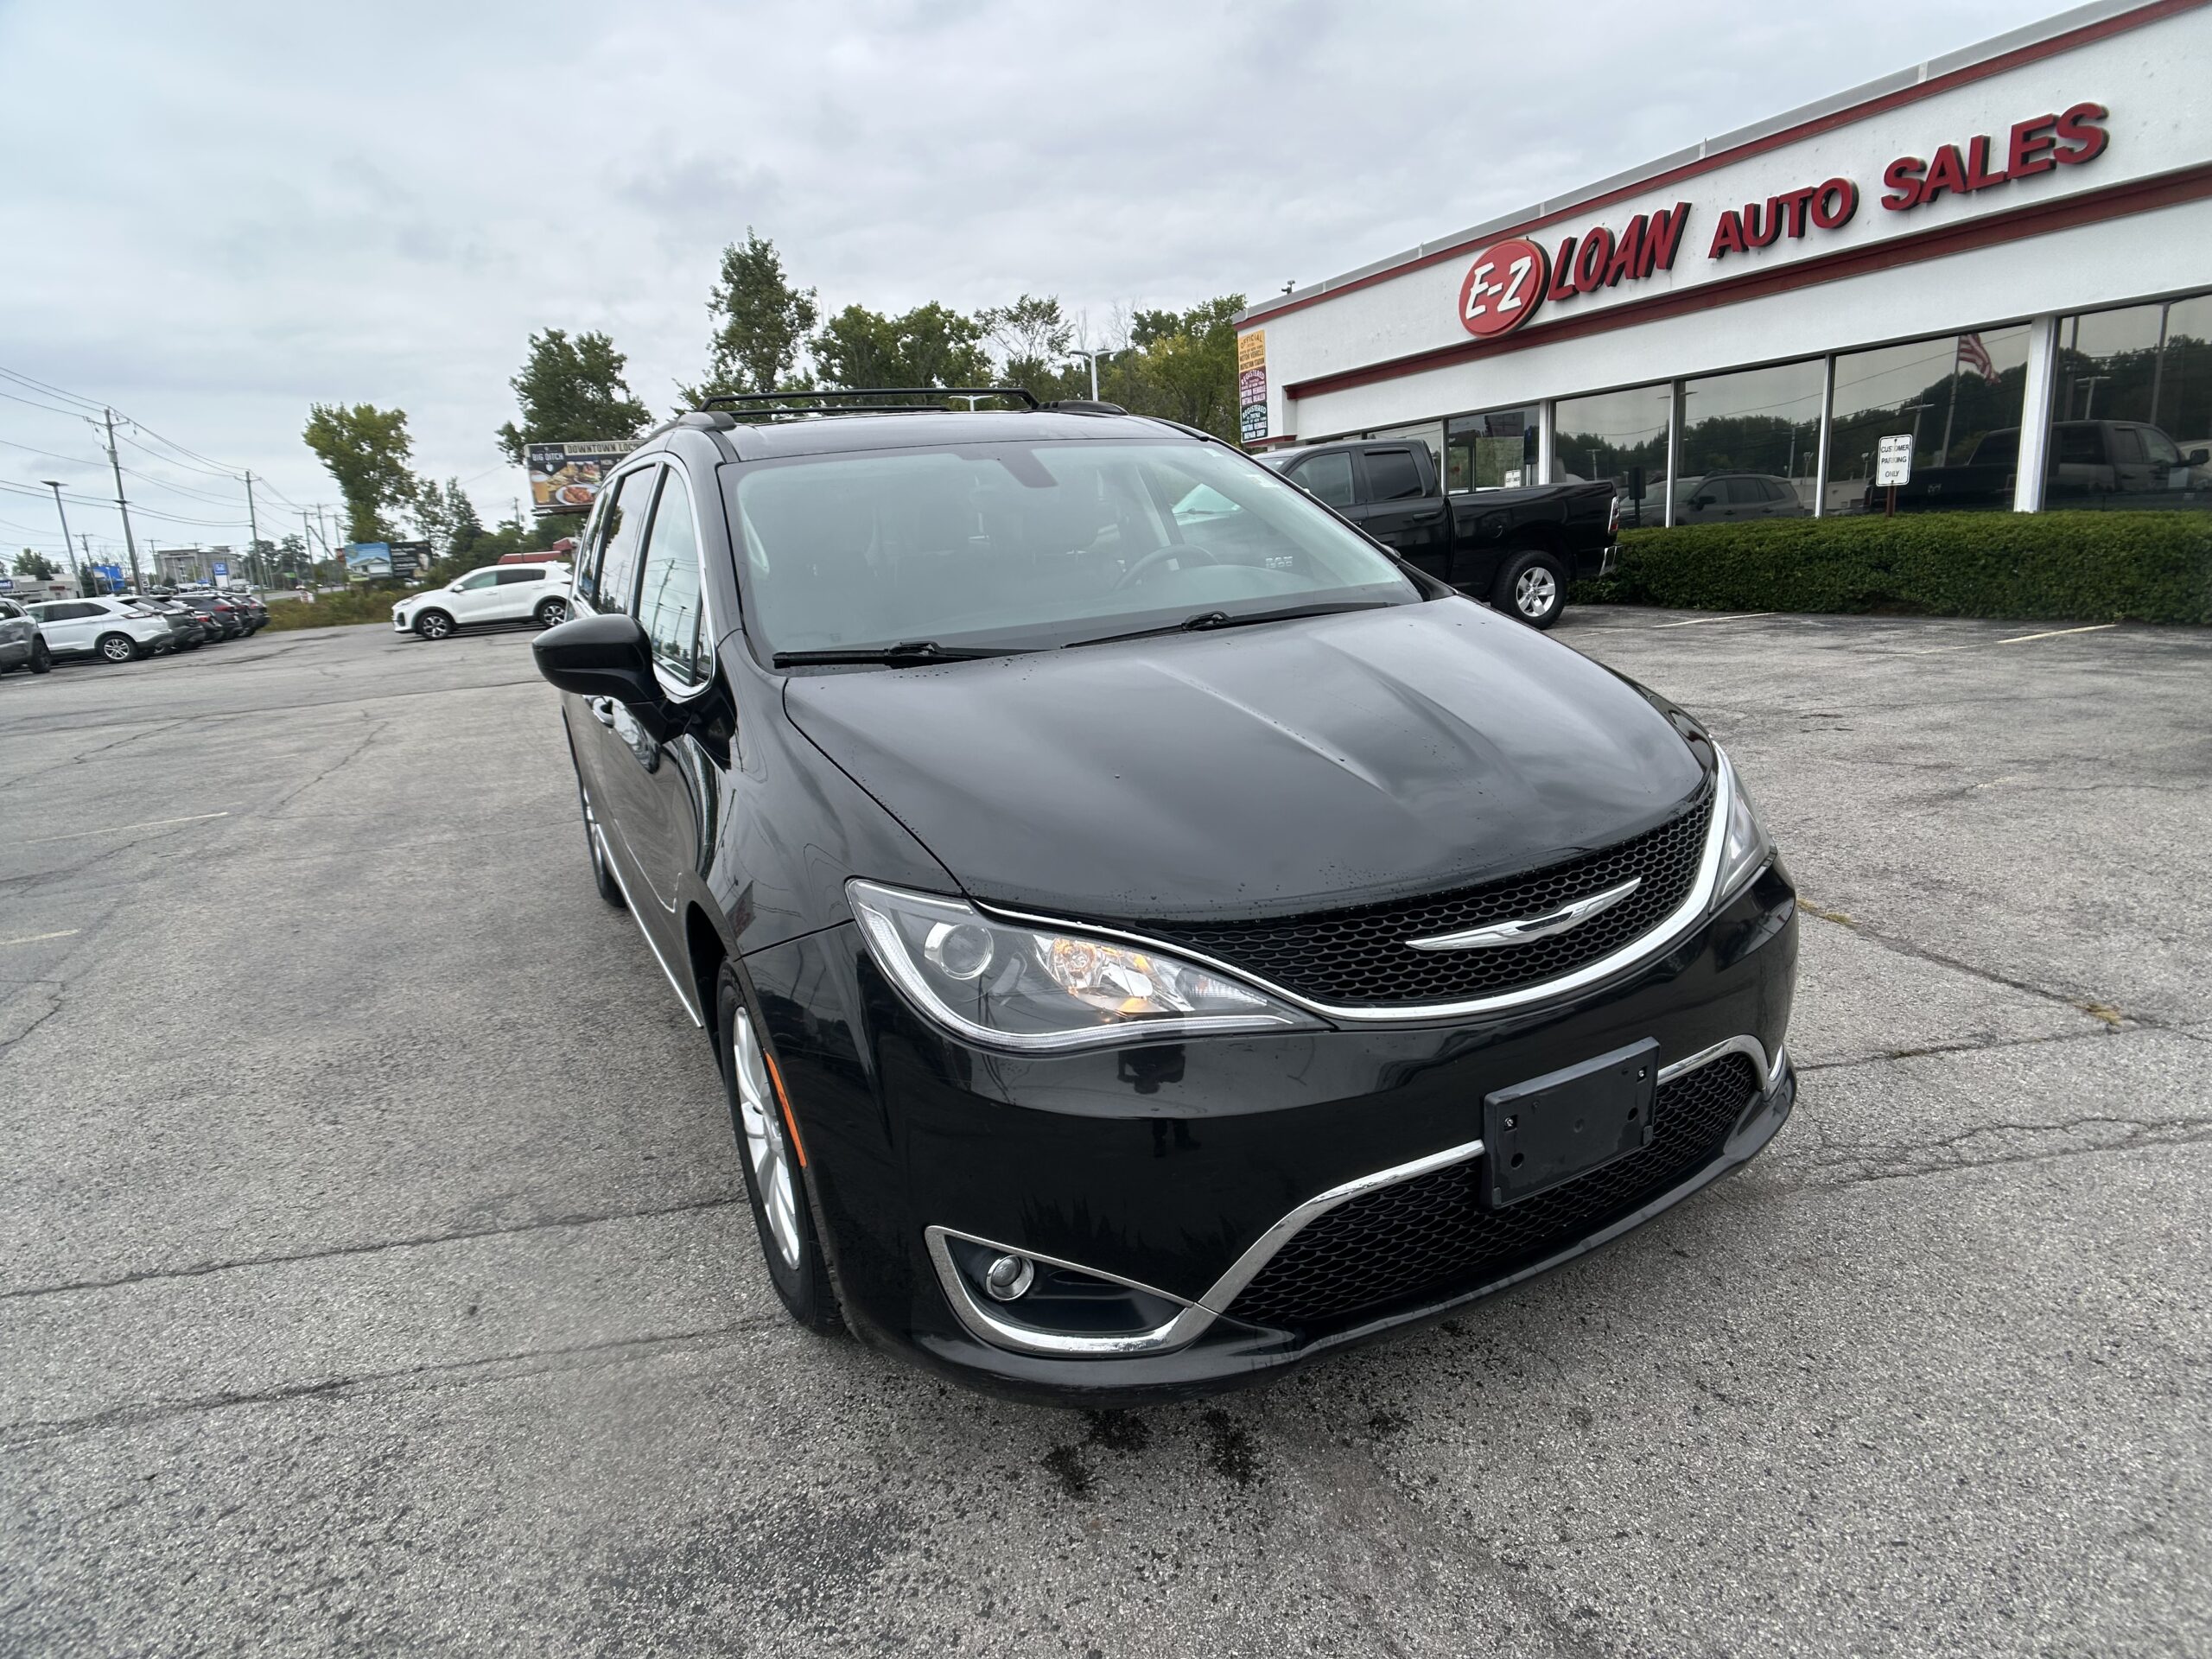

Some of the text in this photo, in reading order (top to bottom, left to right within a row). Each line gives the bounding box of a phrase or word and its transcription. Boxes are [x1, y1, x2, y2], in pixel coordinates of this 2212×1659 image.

[1465, 101, 2110, 321] E-Z LOAN AUTO SALES
[1241, 334, 1262, 349] OFFICIAL
[1240, 348, 1263, 362] MOTOR VEHICLE
[1241, 370, 1265, 385] REGISTERED
[1243, 405, 1266, 419] REGISTERED
[1243, 429, 1266, 440] REPAIR SHOP
[568, 442, 616, 454] DOWNTOWN
[1881, 444, 1909, 453] CUSOMER
[532, 452, 564, 461] BIG DITCH
[1881, 456, 1907, 465] PARKING
